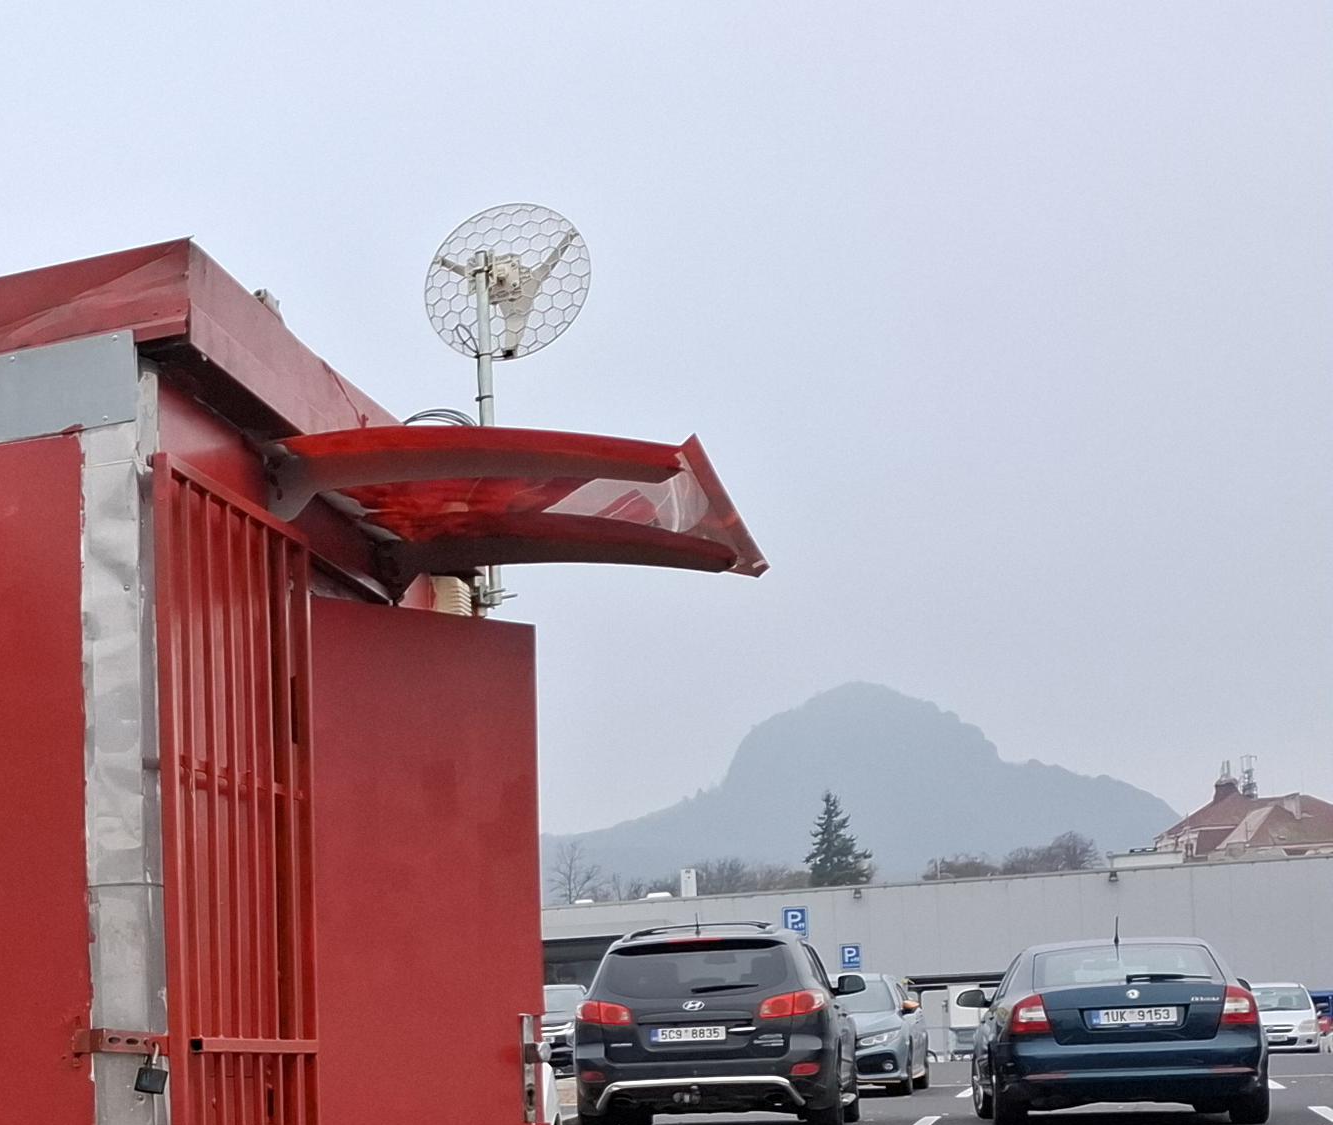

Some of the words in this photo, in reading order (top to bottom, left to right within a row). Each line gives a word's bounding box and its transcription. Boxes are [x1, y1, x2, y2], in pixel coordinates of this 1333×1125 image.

[787, 911, 802, 929] P
[844, 947, 857, 963] P
[1104, 1011, 1127, 1023] 1UK
[1137, 1008, 1171, 1022] 9153
[661, 1029, 682, 1040] 5C9
[691, 1028, 721, 1039] 8835
